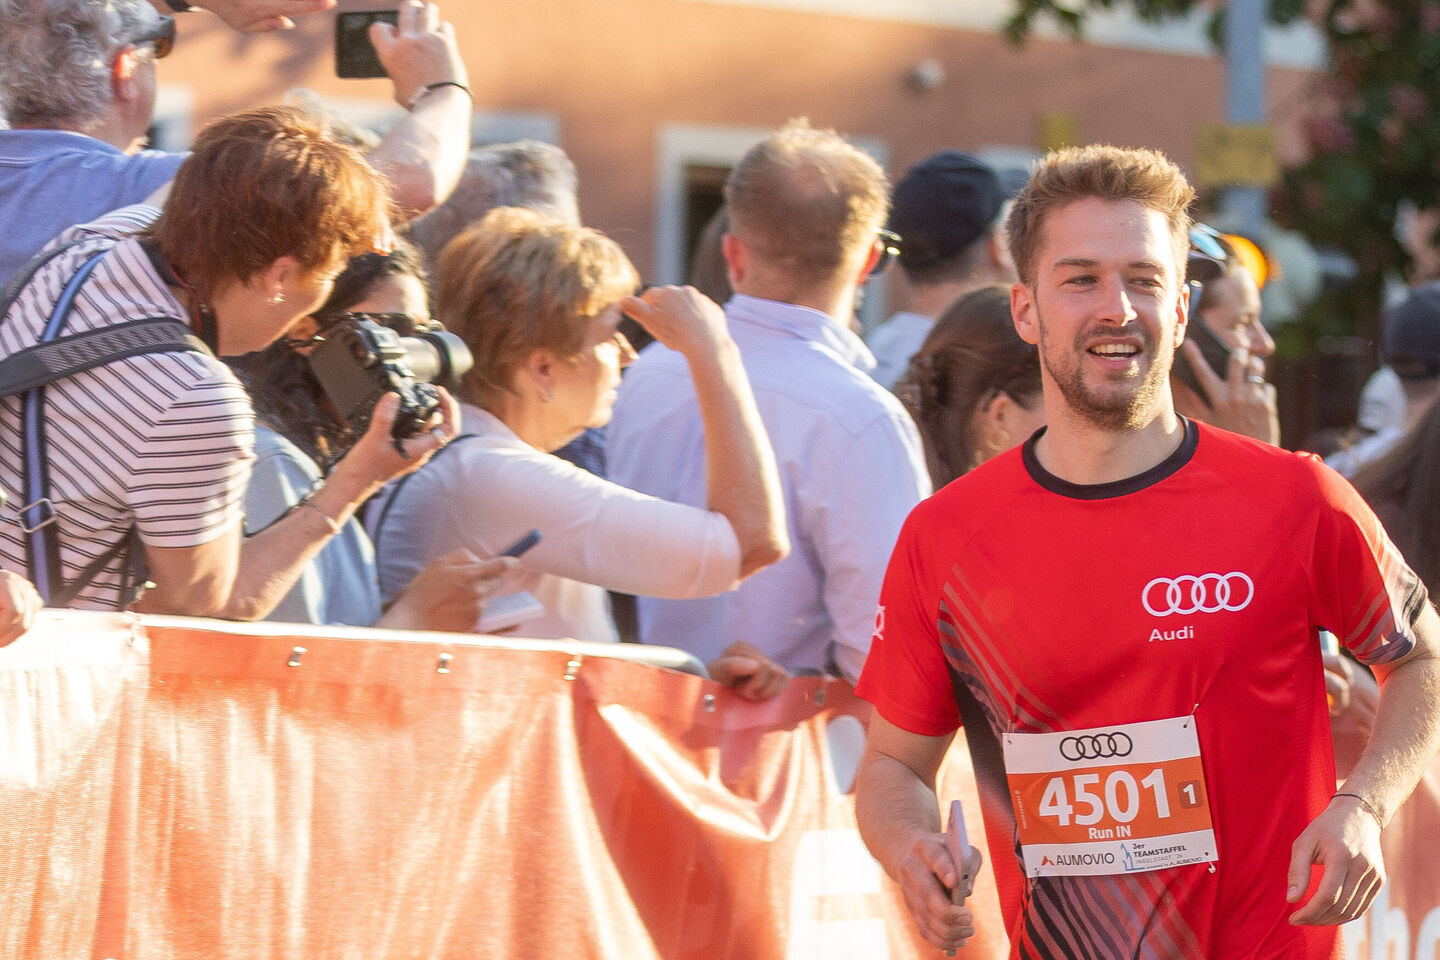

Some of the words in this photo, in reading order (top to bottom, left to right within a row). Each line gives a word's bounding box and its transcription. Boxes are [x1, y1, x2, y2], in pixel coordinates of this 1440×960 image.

[1148, 625, 1194, 642] Audi
[1038, 768, 1171, 826] 4501
[1182, 783, 1197, 805] 1
[1088, 827, 1114, 840] Run
[1116, 825, 1132, 838] IN
[1132, 842, 1145, 850] 3er
[1133, 845, 1187, 858] TEAMSTAFFEL
[1056, 852, 1115, 866] AUMOVIO
